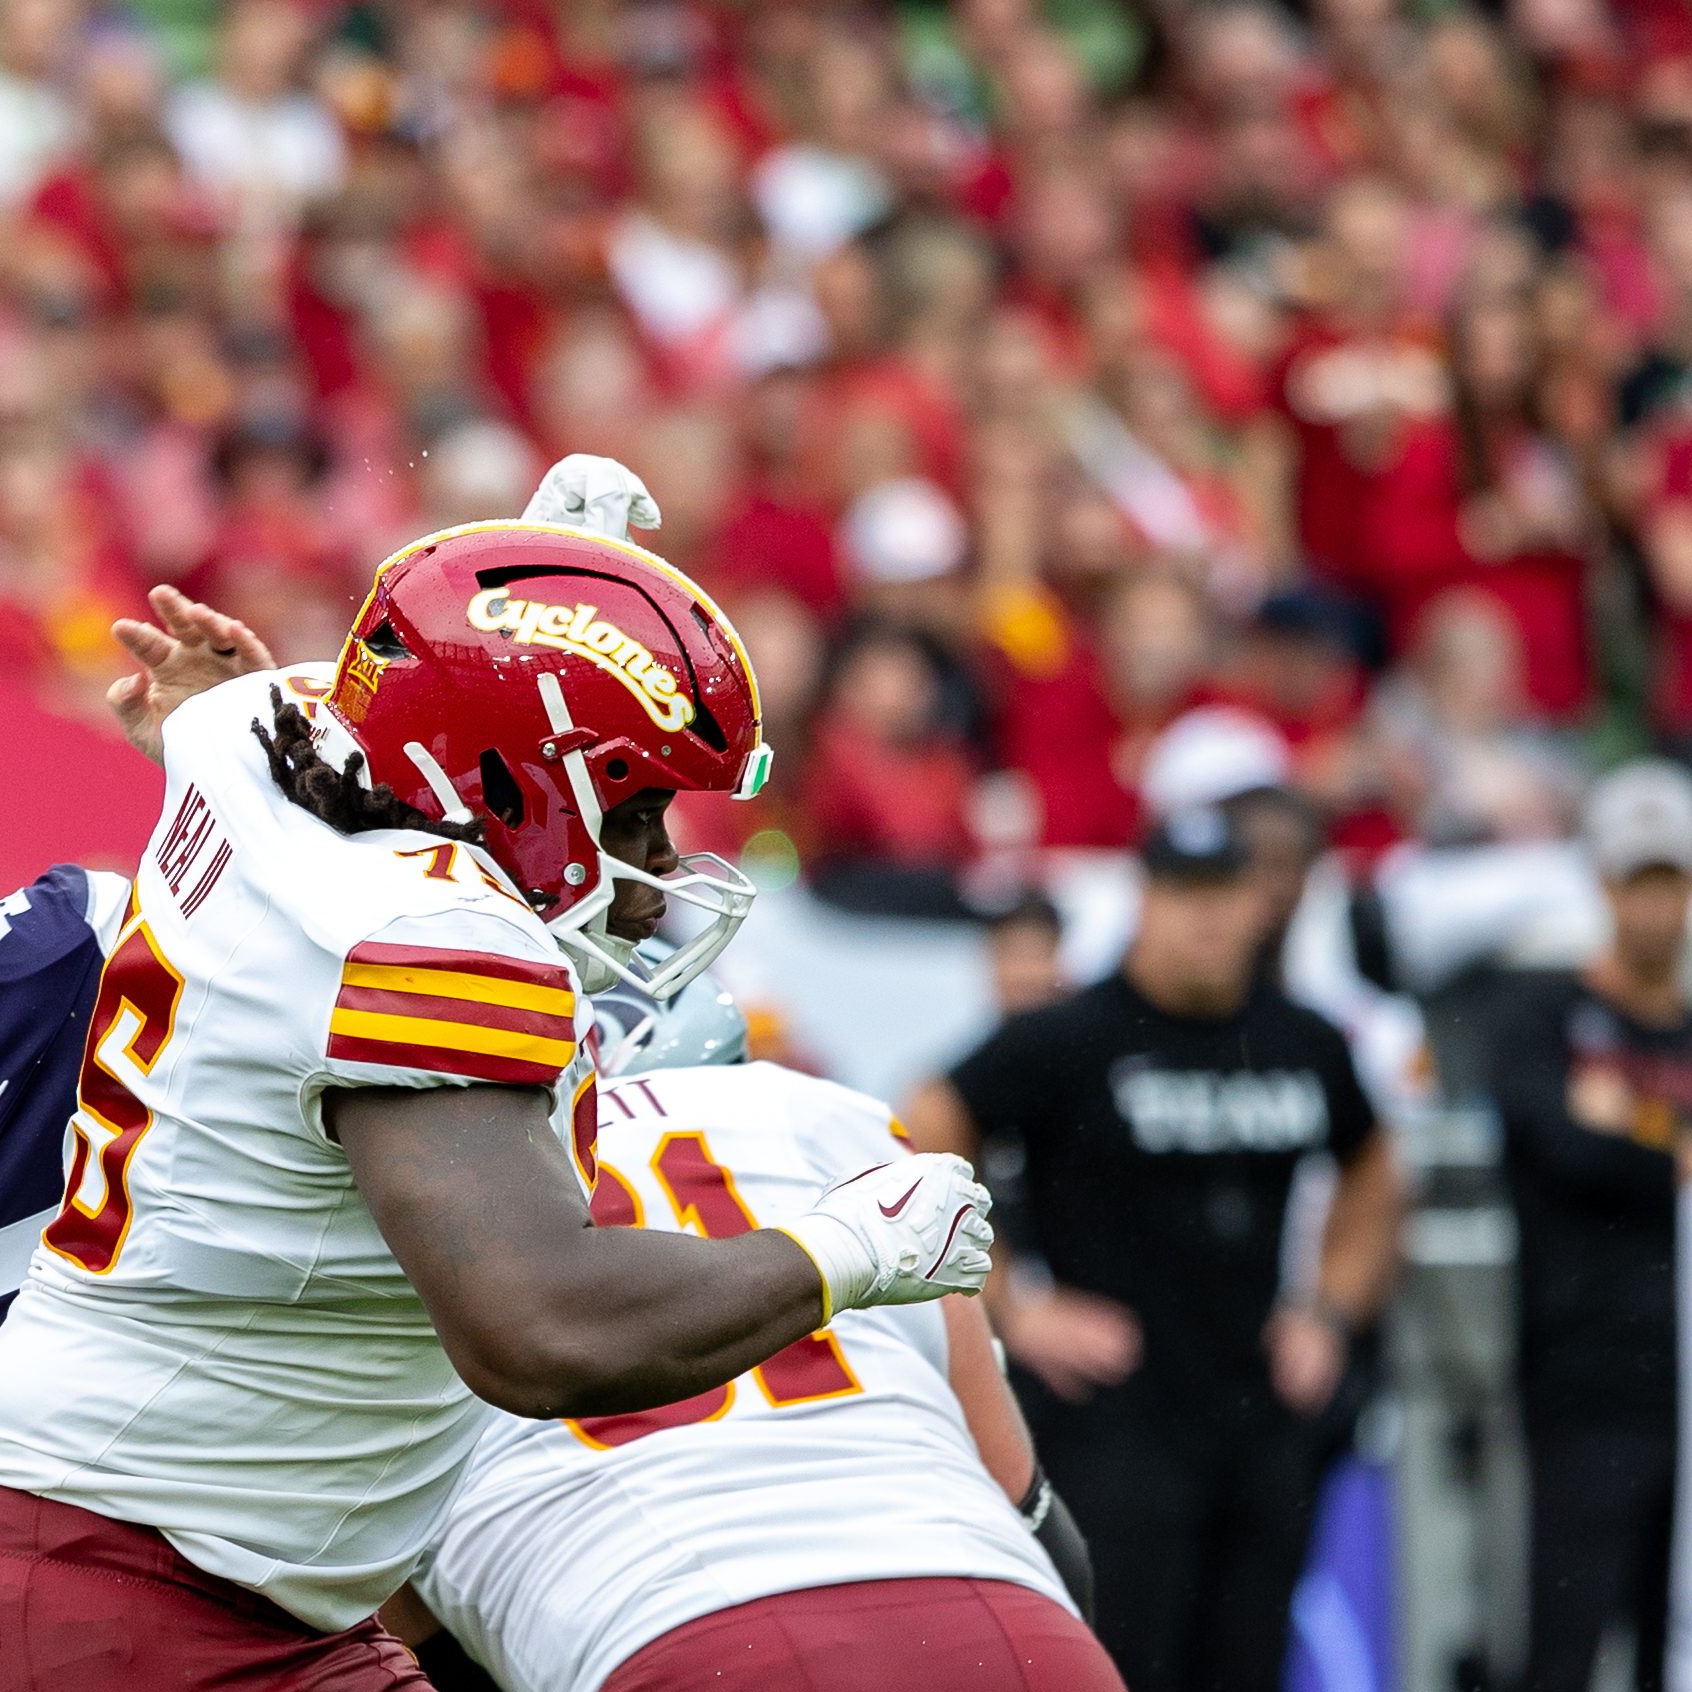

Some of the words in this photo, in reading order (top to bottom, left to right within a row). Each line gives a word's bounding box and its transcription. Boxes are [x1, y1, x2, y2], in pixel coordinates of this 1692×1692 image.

[467, 587, 694, 732] Cyclones
[155, 782, 216, 897] NEAL
[180, 837, 233, 921] III
[43, 877, 185, 1275] 6
